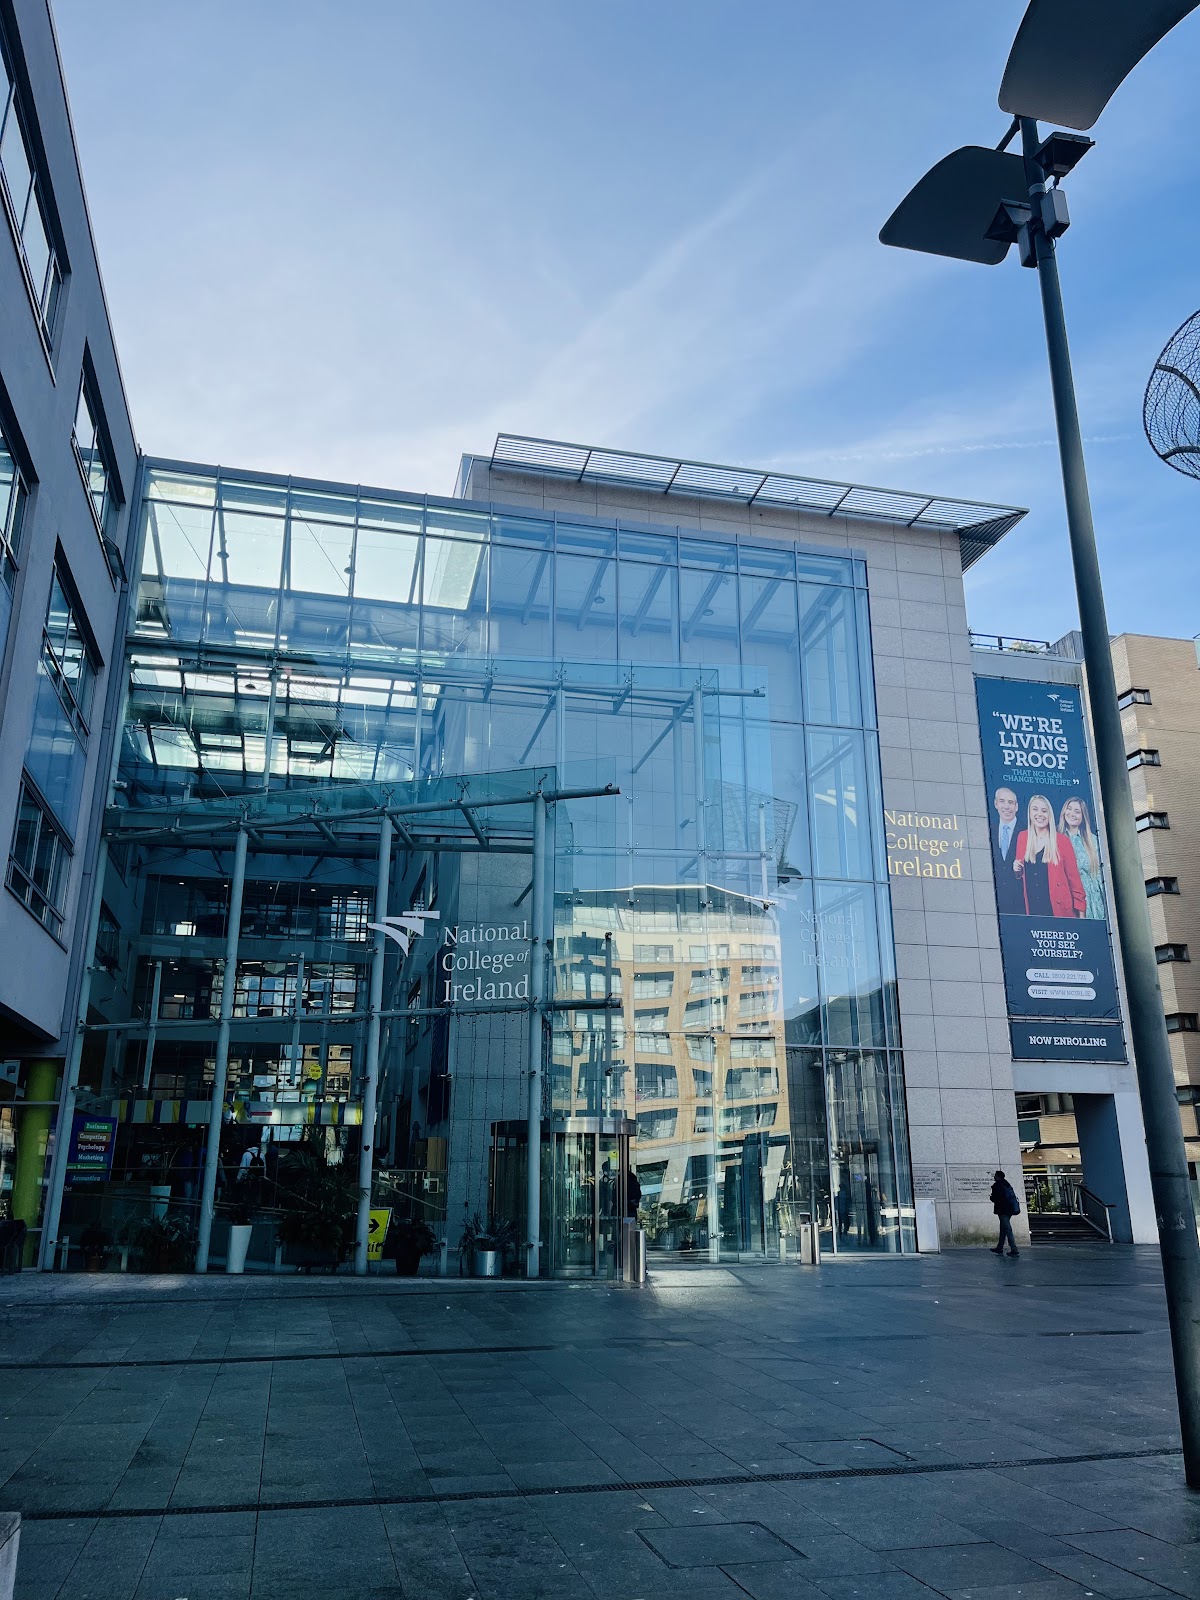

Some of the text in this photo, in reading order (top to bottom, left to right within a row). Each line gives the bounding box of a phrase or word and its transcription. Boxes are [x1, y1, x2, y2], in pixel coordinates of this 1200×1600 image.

[999, 731, 1068, 752] LIVING
[1003, 750, 1068, 770] PROOF
[1003, 775, 1034, 783] CHANGE
[1012, 769, 1031, 777] THAT
[884, 810, 958, 830] National
[886, 833, 964, 856] College of
[888, 856, 963, 879] Ireland
[444, 921, 528, 946] National
[1031, 930, 1079, 940] WHERE DO
[1031, 949, 1083, 959] YOURSELF?
[1037, 940, 1075, 949] YOU SEE
[442, 949, 530, 974] College of
[444, 975, 530, 1002] Ireland
[1029, 1036, 1107, 1046] NOW ENROLLING
